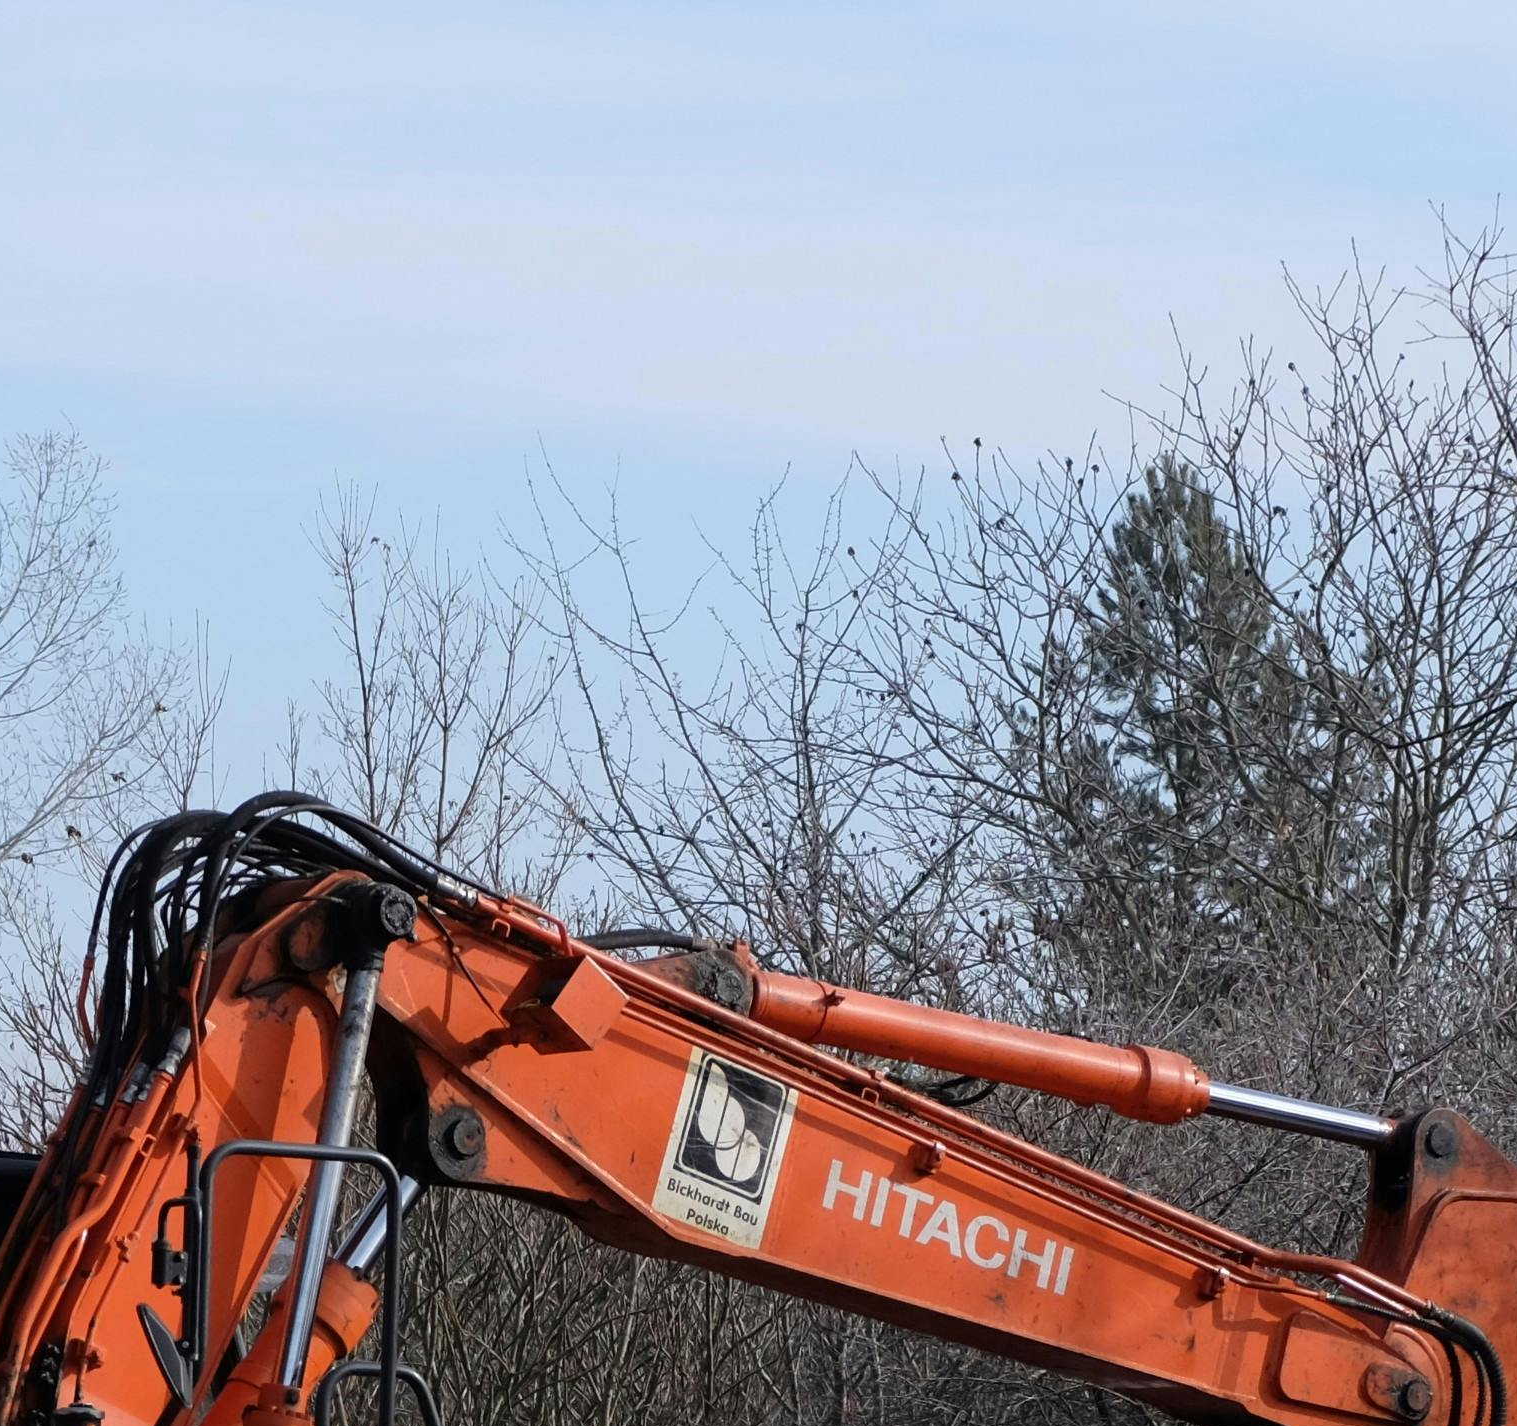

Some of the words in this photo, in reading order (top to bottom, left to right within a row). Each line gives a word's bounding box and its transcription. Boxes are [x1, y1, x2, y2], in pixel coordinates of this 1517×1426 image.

[666, 1178, 730, 1213] Bickhardt
[733, 1205, 758, 1226] Bau
[686, 1208, 729, 1236] Polska
[822, 1158, 1075, 1295] HITACHI
